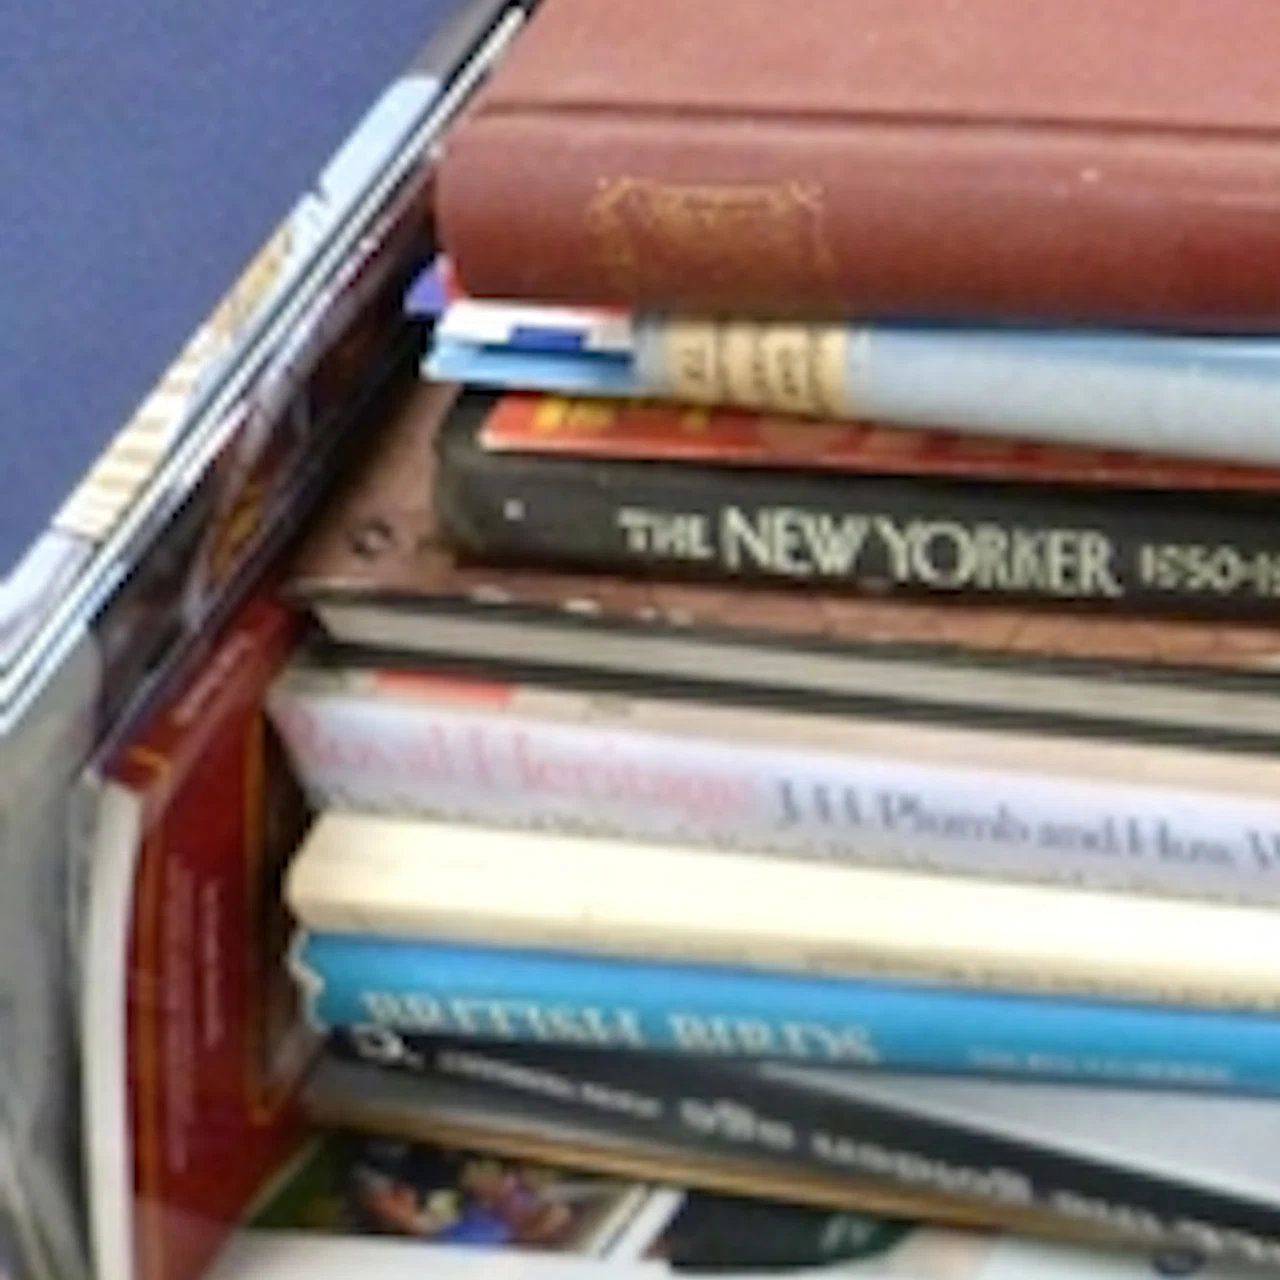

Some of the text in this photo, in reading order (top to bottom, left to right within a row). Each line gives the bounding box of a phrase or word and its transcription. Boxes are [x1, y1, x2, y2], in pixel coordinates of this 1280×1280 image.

[618, 507, 714, 560] THE
[718, 504, 873, 576] NEW
[874, 515, 1125, 598] YORKER
